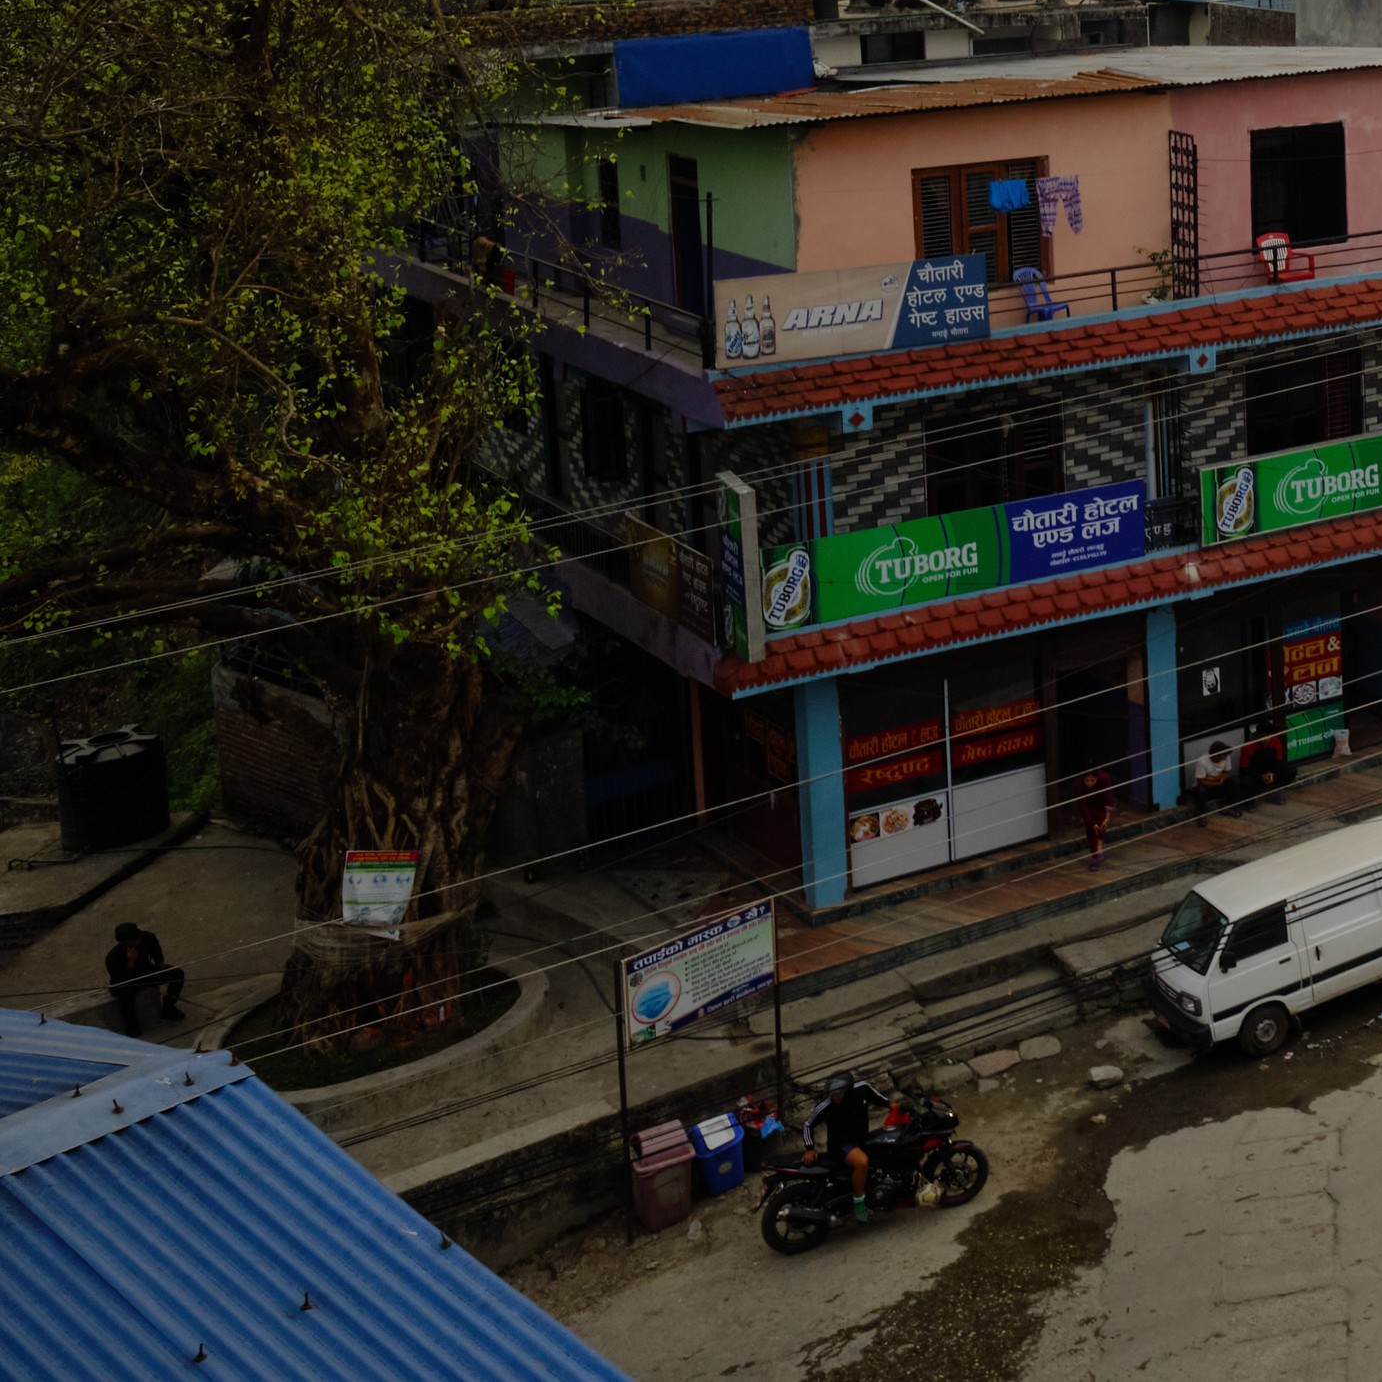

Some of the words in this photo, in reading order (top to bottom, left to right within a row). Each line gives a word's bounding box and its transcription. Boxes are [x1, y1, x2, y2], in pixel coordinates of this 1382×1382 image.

[917, 260, 965, 285] चौतारी
[907, 287, 947, 308] होटल
[954, 282, 985, 303] एण्ड
[782, 298, 884, 331] ARNA
[908, 307, 939, 329] गेष्ट
[944, 303, 985, 325] हाउस
[1291, 464, 1379, 503] TUBORG
[1331, 493, 1351, 504] OPEN
[1352, 490, 1365, 500] FOR
[1366, 487, 1380, 497] FUN
[1011, 502, 1078, 533] चौतारी
[1084, 493, 1138, 520] होटल
[1221, 481, 1249, 530] TUBORG
[1032, 525, 1075, 549] एण्ड
[1082, 517, 1121, 540] लज
[875, 541, 978, 585] TUBORG
[922, 573, 944, 585] OPEN
[946, 569, 962, 580] FOR
[963, 566, 978, 576] FUN
[769, 559, 806, 622] TUBORG
[1327, 636, 1341, 652] &
[1293, 656, 1339, 681] लज
[919, 724, 940, 744] लज
[687, 923, 726, 947] मास्क
